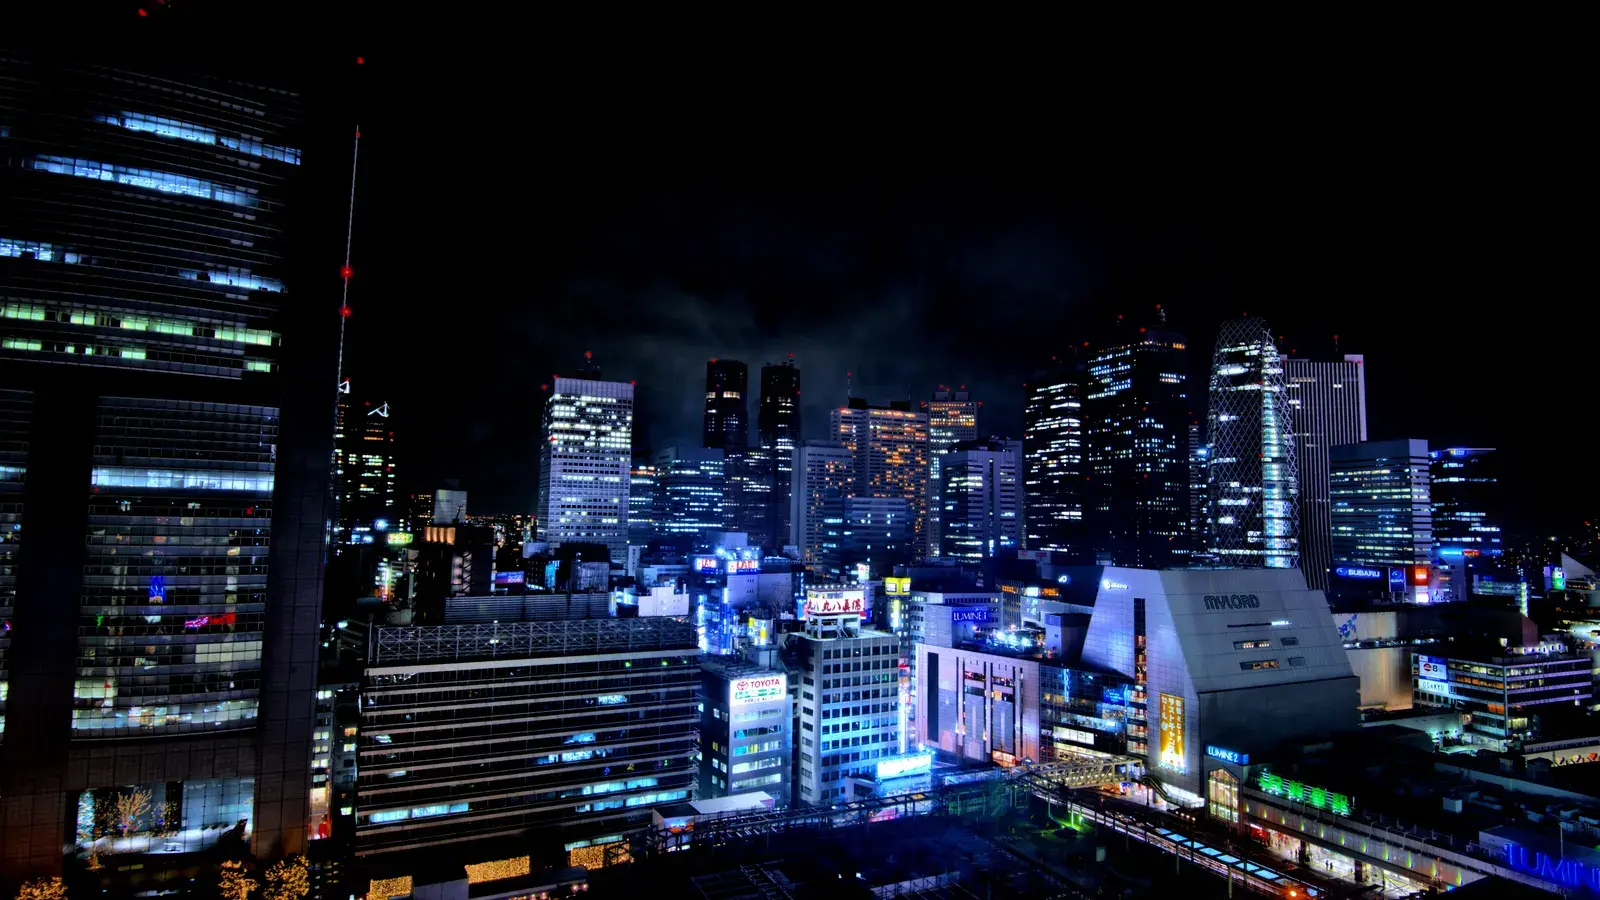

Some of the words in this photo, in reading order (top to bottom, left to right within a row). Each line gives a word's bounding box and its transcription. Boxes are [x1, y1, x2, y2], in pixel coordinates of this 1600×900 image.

[1348, 568, 1380, 578] SUBARU
[1204, 594, 1261, 610] MYLORD
[953, 611, 982, 620] LUMINE
[750, 678, 780, 688] TOYOTA
[1208, 745, 1233, 762] LUMINE
[1233, 753, 1239, 763] 2
